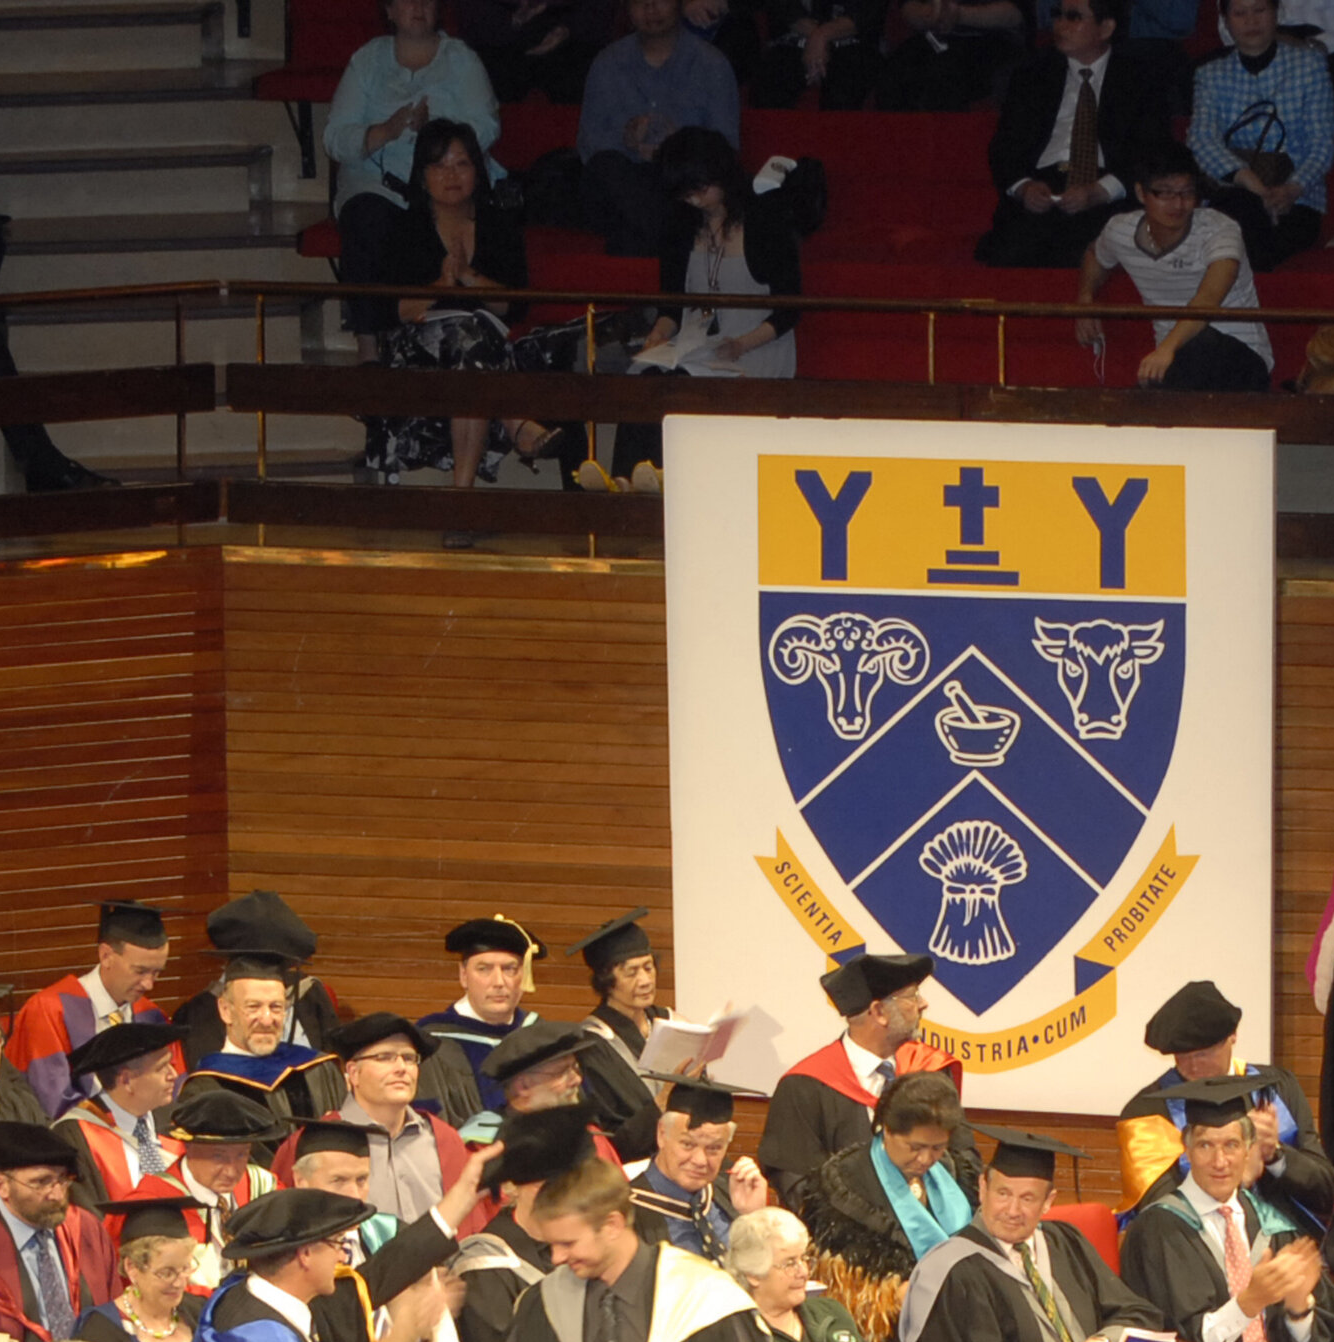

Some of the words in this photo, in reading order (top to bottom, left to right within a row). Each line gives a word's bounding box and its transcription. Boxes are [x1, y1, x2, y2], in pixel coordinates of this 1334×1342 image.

[774, 861, 844, 947] SCIENTIA
[1102, 863, 1177, 953] PROBITATE
[1043, 1004, 1088, 1045] CUM
